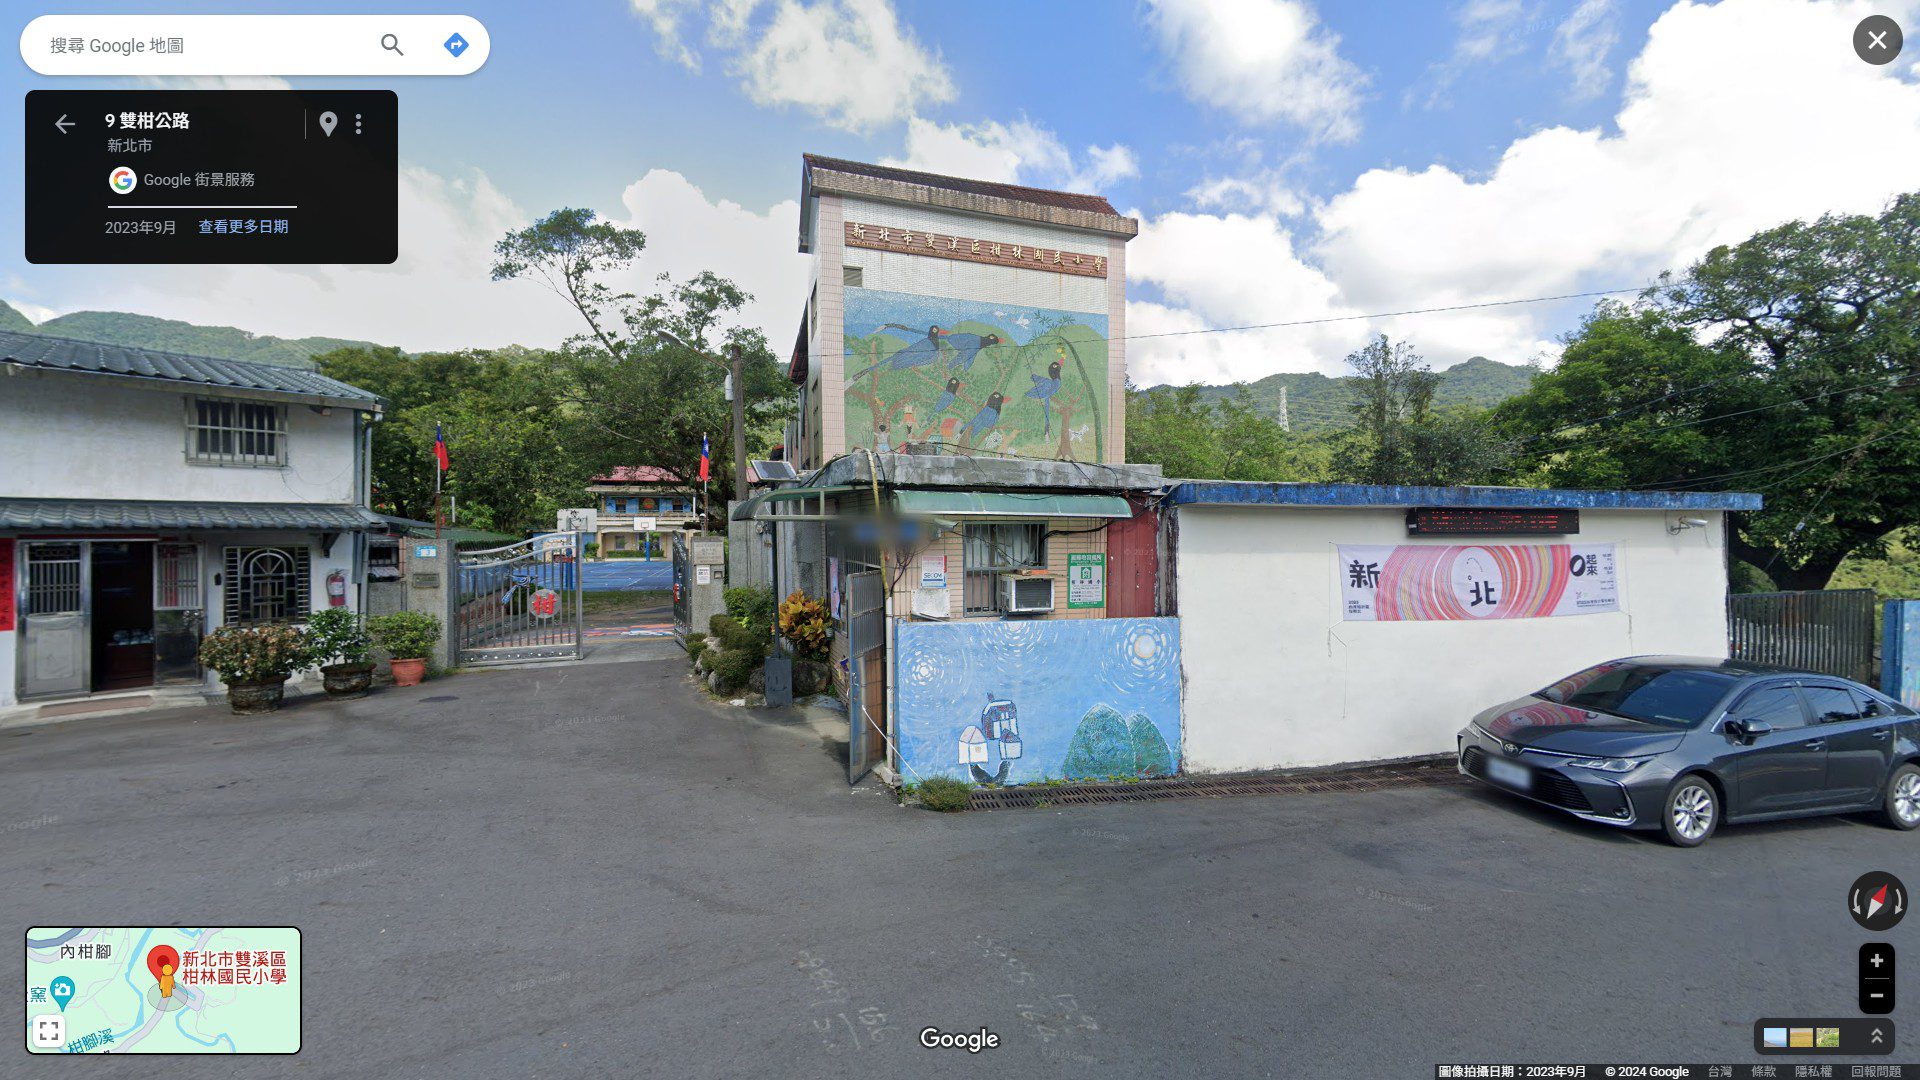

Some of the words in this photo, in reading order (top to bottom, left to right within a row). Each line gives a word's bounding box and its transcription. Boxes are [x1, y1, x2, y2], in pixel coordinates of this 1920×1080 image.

[1349, 560, 1380, 588] 新
[1470, 581, 1497, 606] 北
[1586, 554, 1598, 576] 起來
[532, 593, 557, 616] 柑
